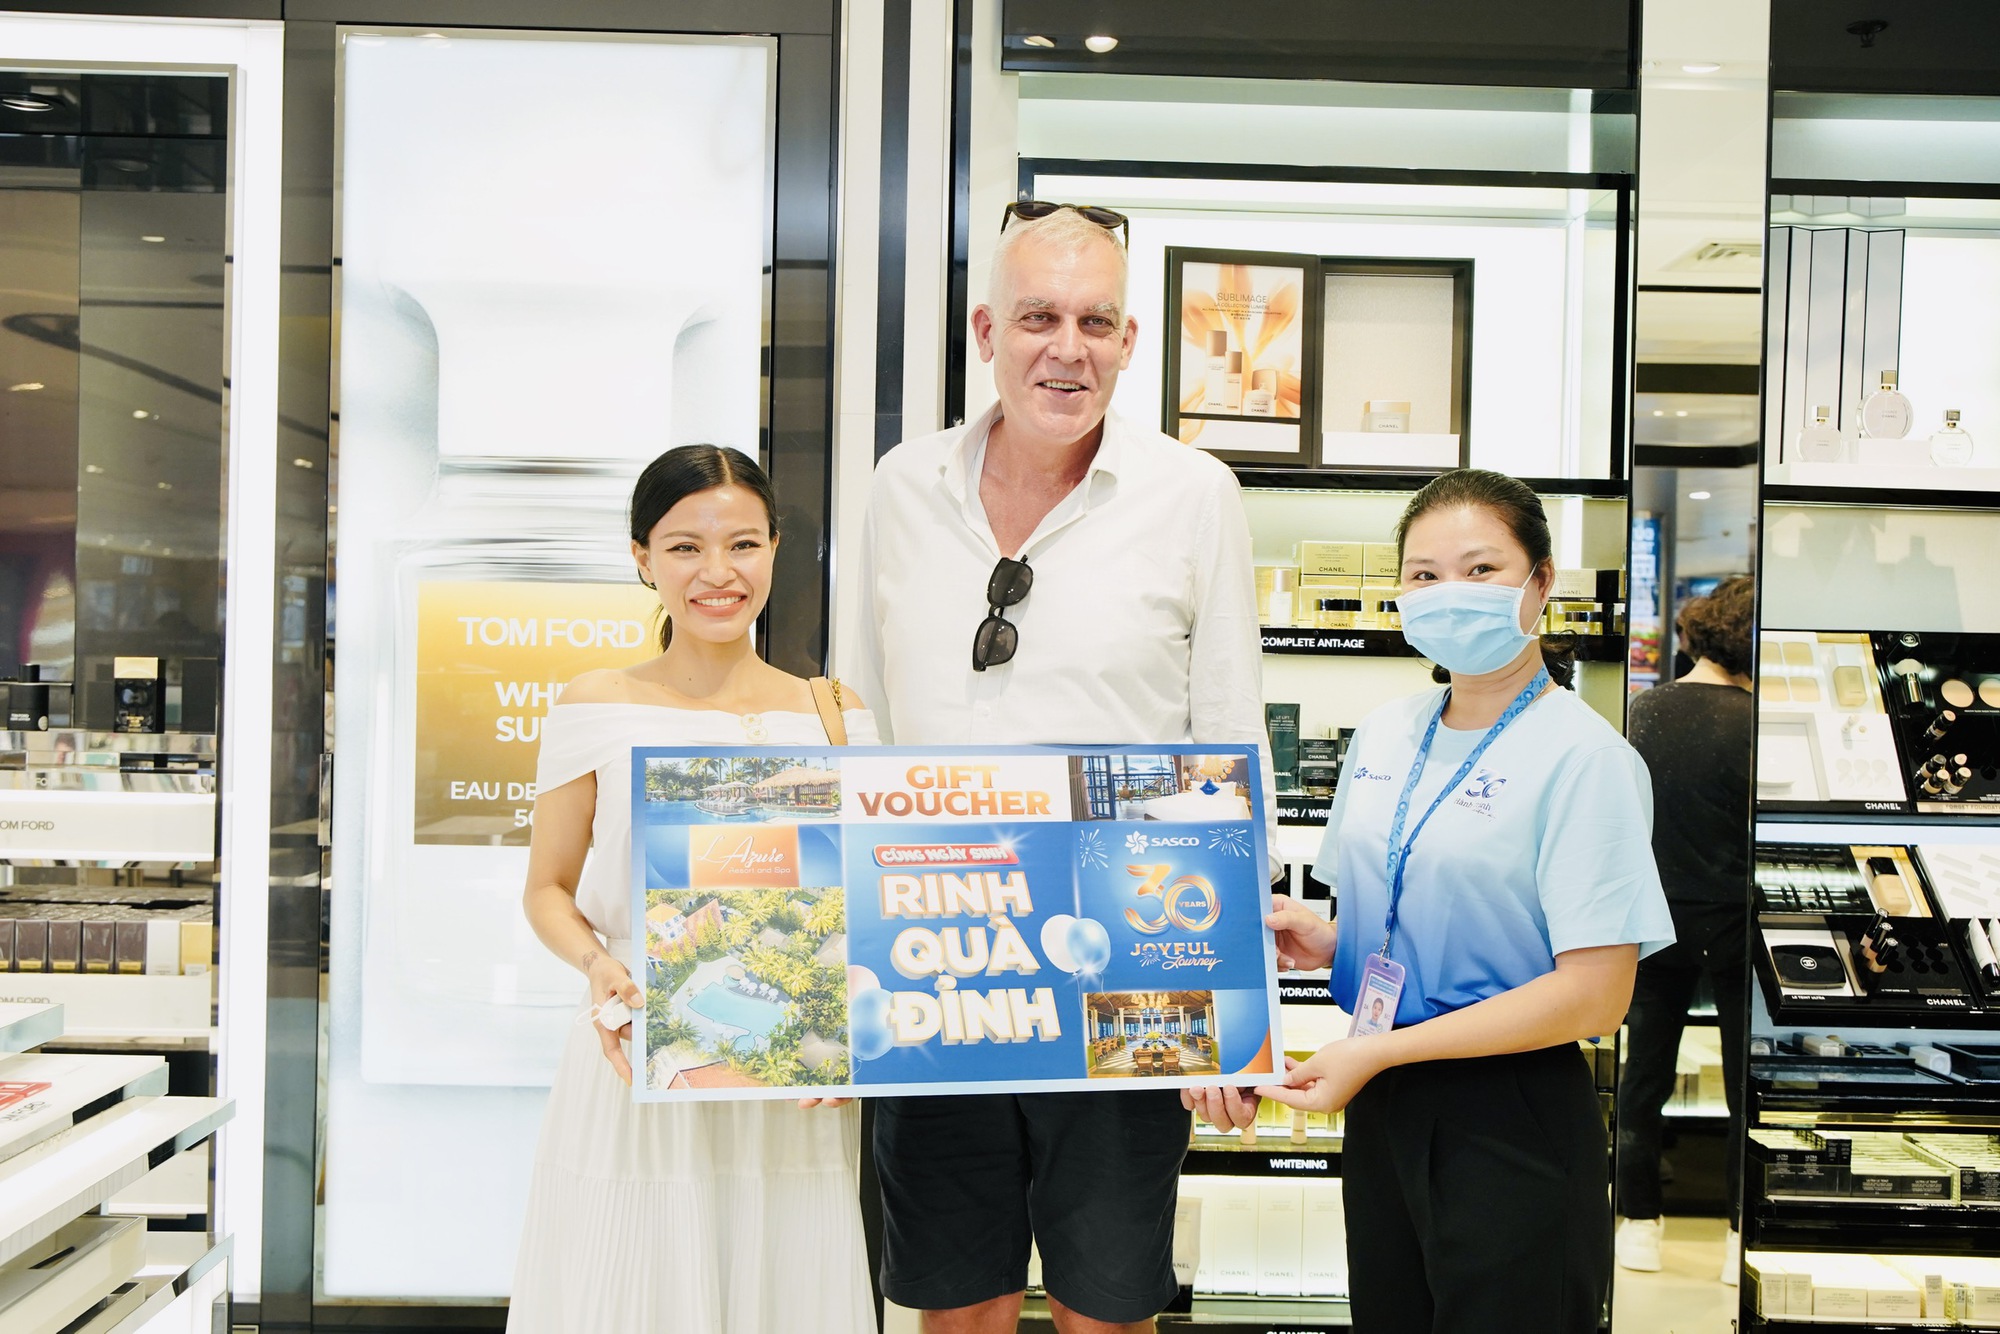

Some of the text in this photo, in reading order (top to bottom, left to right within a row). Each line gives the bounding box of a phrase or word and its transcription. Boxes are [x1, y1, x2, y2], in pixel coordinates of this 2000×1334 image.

[1217, 292, 1267, 303] SUBLIMAGE
[457, 617, 646, 648] TOM FORD
[1261, 636, 1365, 649] COMPLETE ANTI-AGE
[494, 681, 570, 708] WHI
[496, 715, 548, 743] SU
[906, 765, 1000, 789] GIFT
[451, 781, 538, 801] EAU DE
[857, 791, 1052, 817] VOUCHER
[1865, 802, 1902, 811] CHANEL
[21, 820, 55, 830] FORD
[1150, 836, 1200, 847] SASCO
[969, 847, 1009, 861] SINH
[728, 866, 791, 875] Resort and Spa
[880, 871, 1034, 920] RINH
[1124, 863, 1222, 935] 30
[1178, 900, 1207, 908] YEARS
[891, 915, 1041, 980] QUÀ
[1129, 941, 1215, 957] JOYFUL
[1161, 954, 1223, 972] Journey
[887, 975, 1062, 1046] ĐỈNH
[1926, 998, 1966, 1006] CHANEL
[1269, 1158, 1328, 1170] WHITENING
